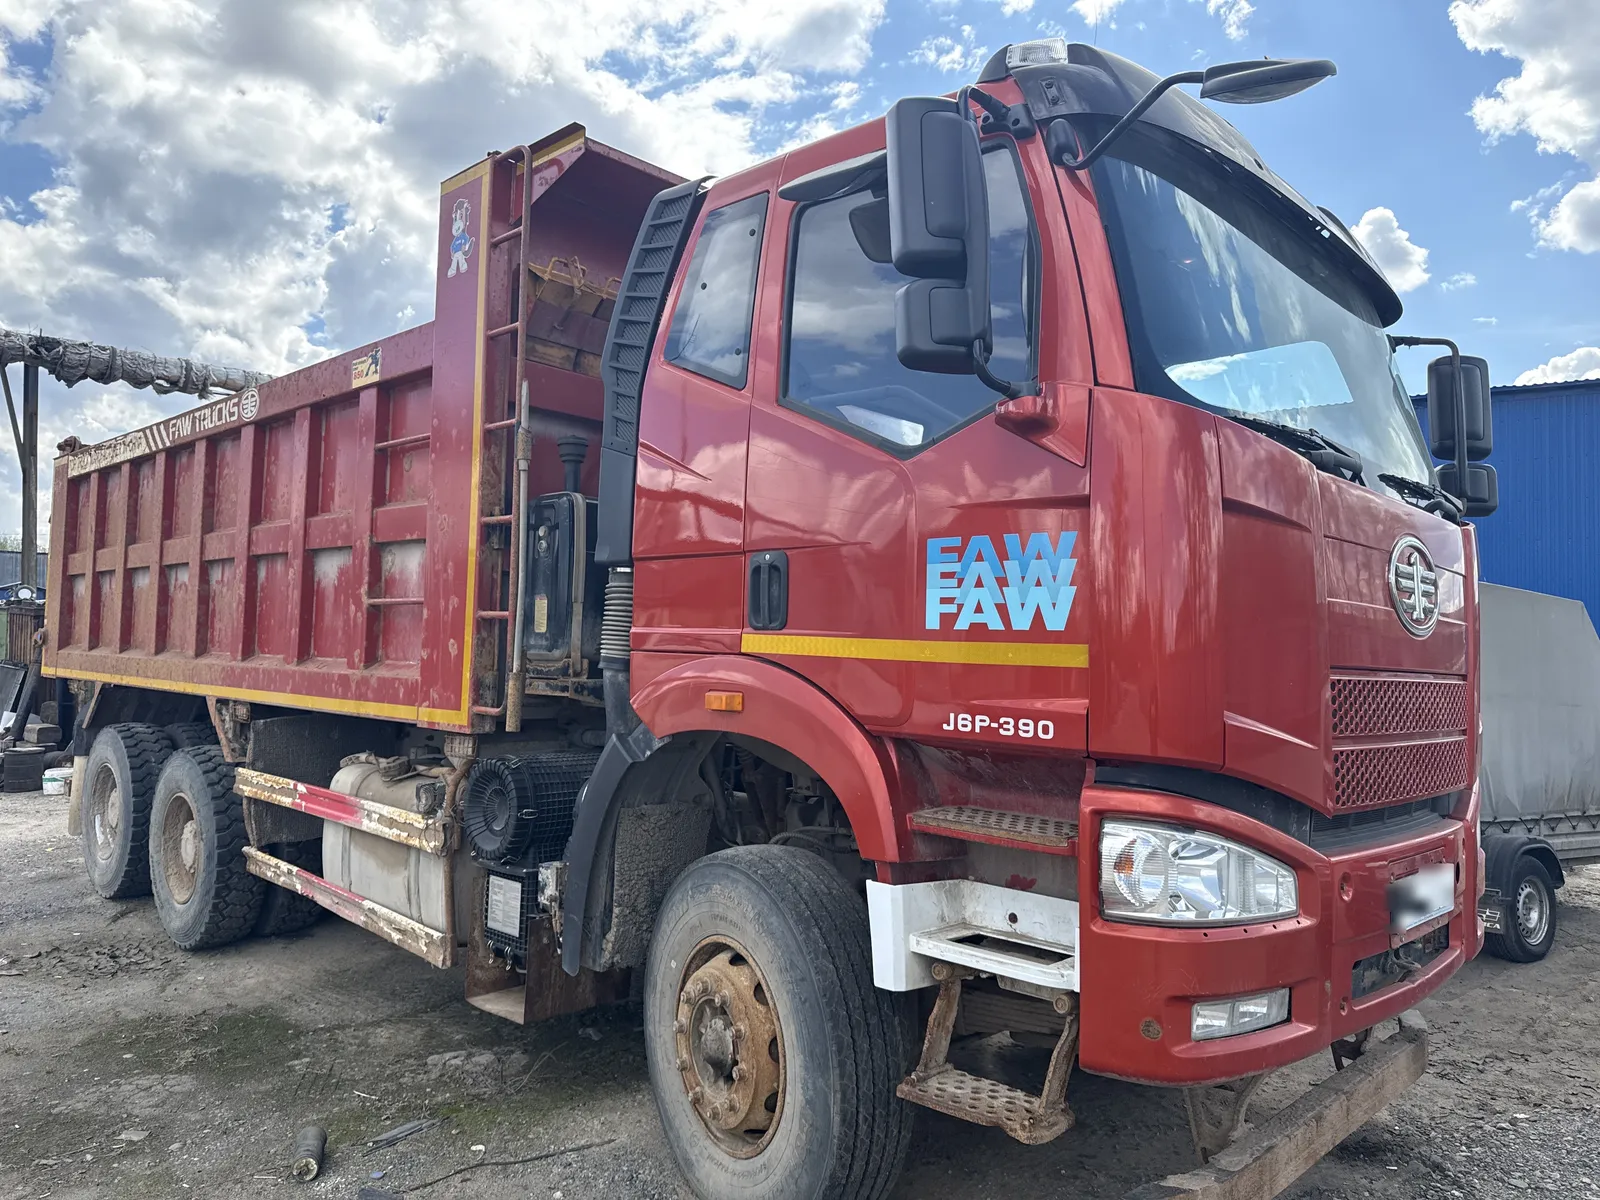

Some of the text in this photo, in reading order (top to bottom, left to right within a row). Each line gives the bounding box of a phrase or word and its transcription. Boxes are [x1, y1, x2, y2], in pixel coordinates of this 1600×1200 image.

[169, 397, 239, 441] FAW TRUCKS
[925, 585, 1078, 631] FAW
[942, 712, 1055, 740] J6P-390
